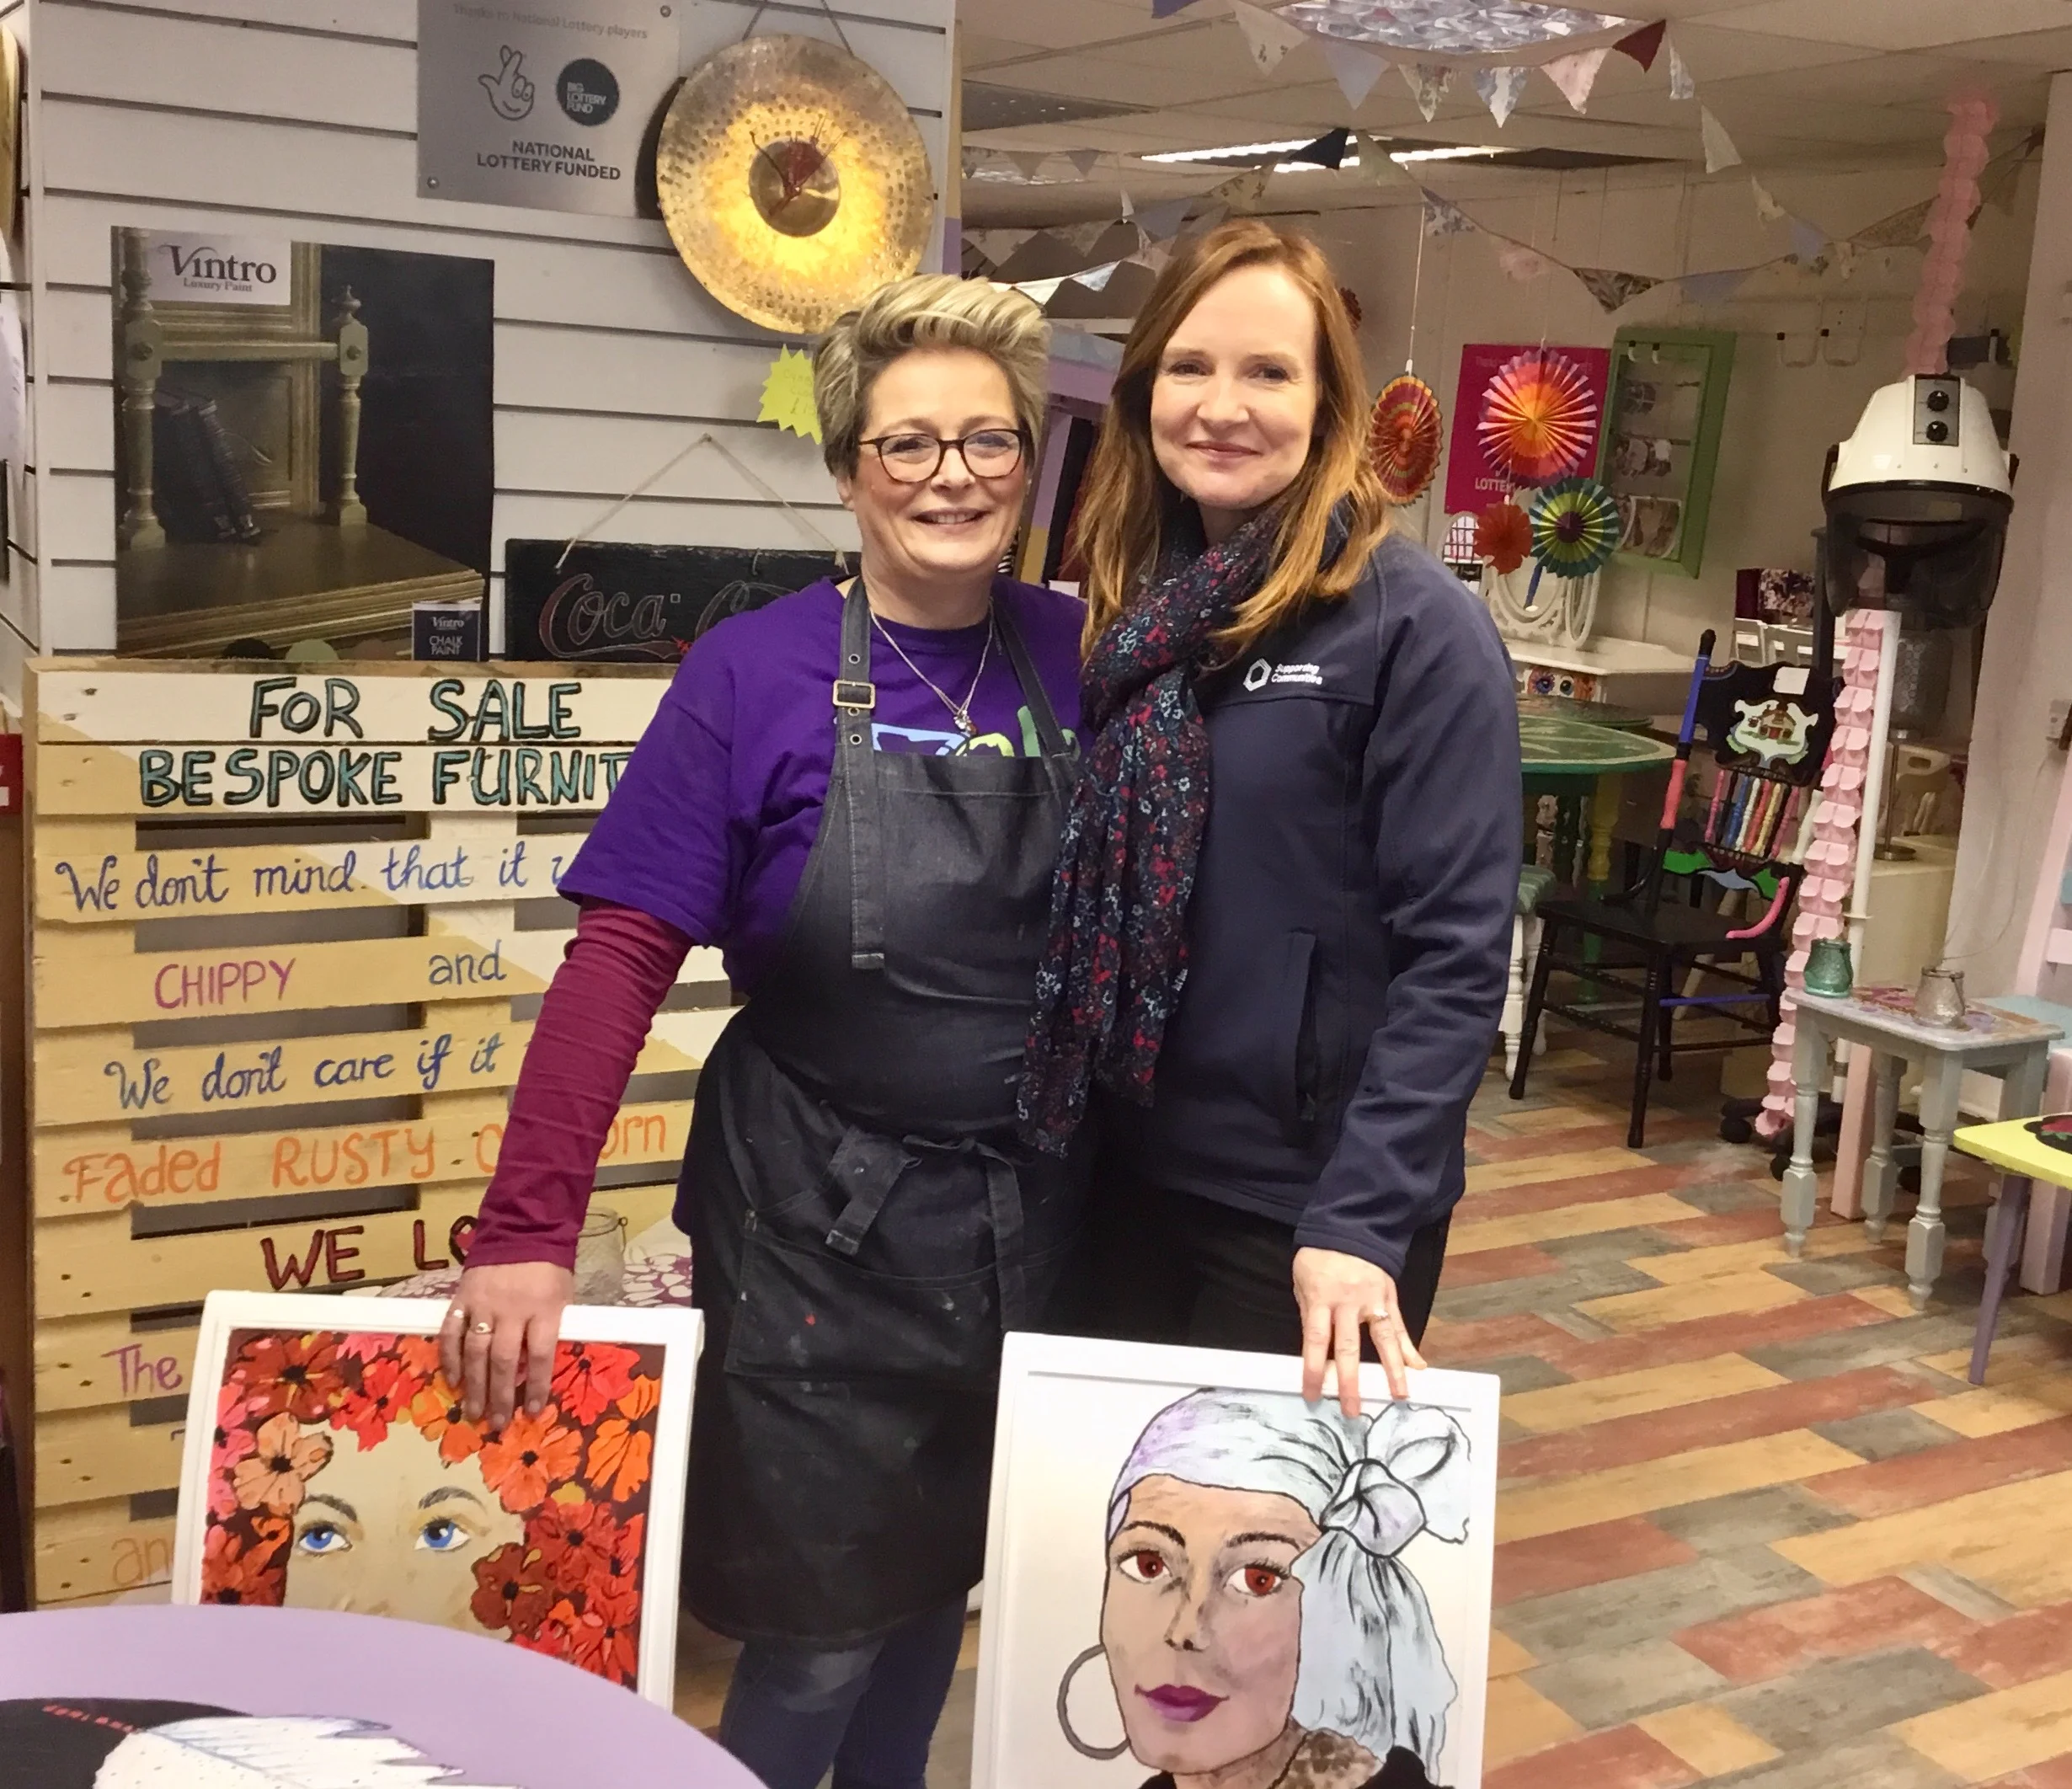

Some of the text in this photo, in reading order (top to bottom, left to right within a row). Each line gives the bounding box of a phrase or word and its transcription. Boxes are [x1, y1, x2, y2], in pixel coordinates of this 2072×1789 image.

[454, 3, 494, 19] Thanks
[513, 10, 560, 28] National
[562, 17, 605, 35] Lottery
[606, 24, 648, 40] players
[567, 92, 607, 105] LOTTERY
[567, 103, 594, 115] FUND
[477, 152, 621, 180] LOTTERY FUNDED
[512, 140, 595, 162] NATIONAL
[158, 244, 277, 284] Vintro
[183, 277, 253, 292] Luxury Paint
[429, 635, 463, 646] CHALK
[430, 616, 465, 628] Vintro
[431, 644, 461, 655] PAINT
[249, 676, 581, 743] FOR SALE
[139, 745, 636, 808] BESPOKE FURNIT
[55, 854, 120, 911] We
[134, 852, 230, 909] don't
[253, 850, 357, 898] mind
[380, 844, 474, 891] that
[499, 841, 529, 888] it
[154, 938, 508, 1010] CHIPPY and
[104, 1032, 505, 1110] We don't care if it
[61, 1113, 667, 1204] Faded RUSTY O orn
[259, 1225, 366, 1291] WE
[100, 1343, 184, 1397] The
[111, 1535, 175, 1589] an
